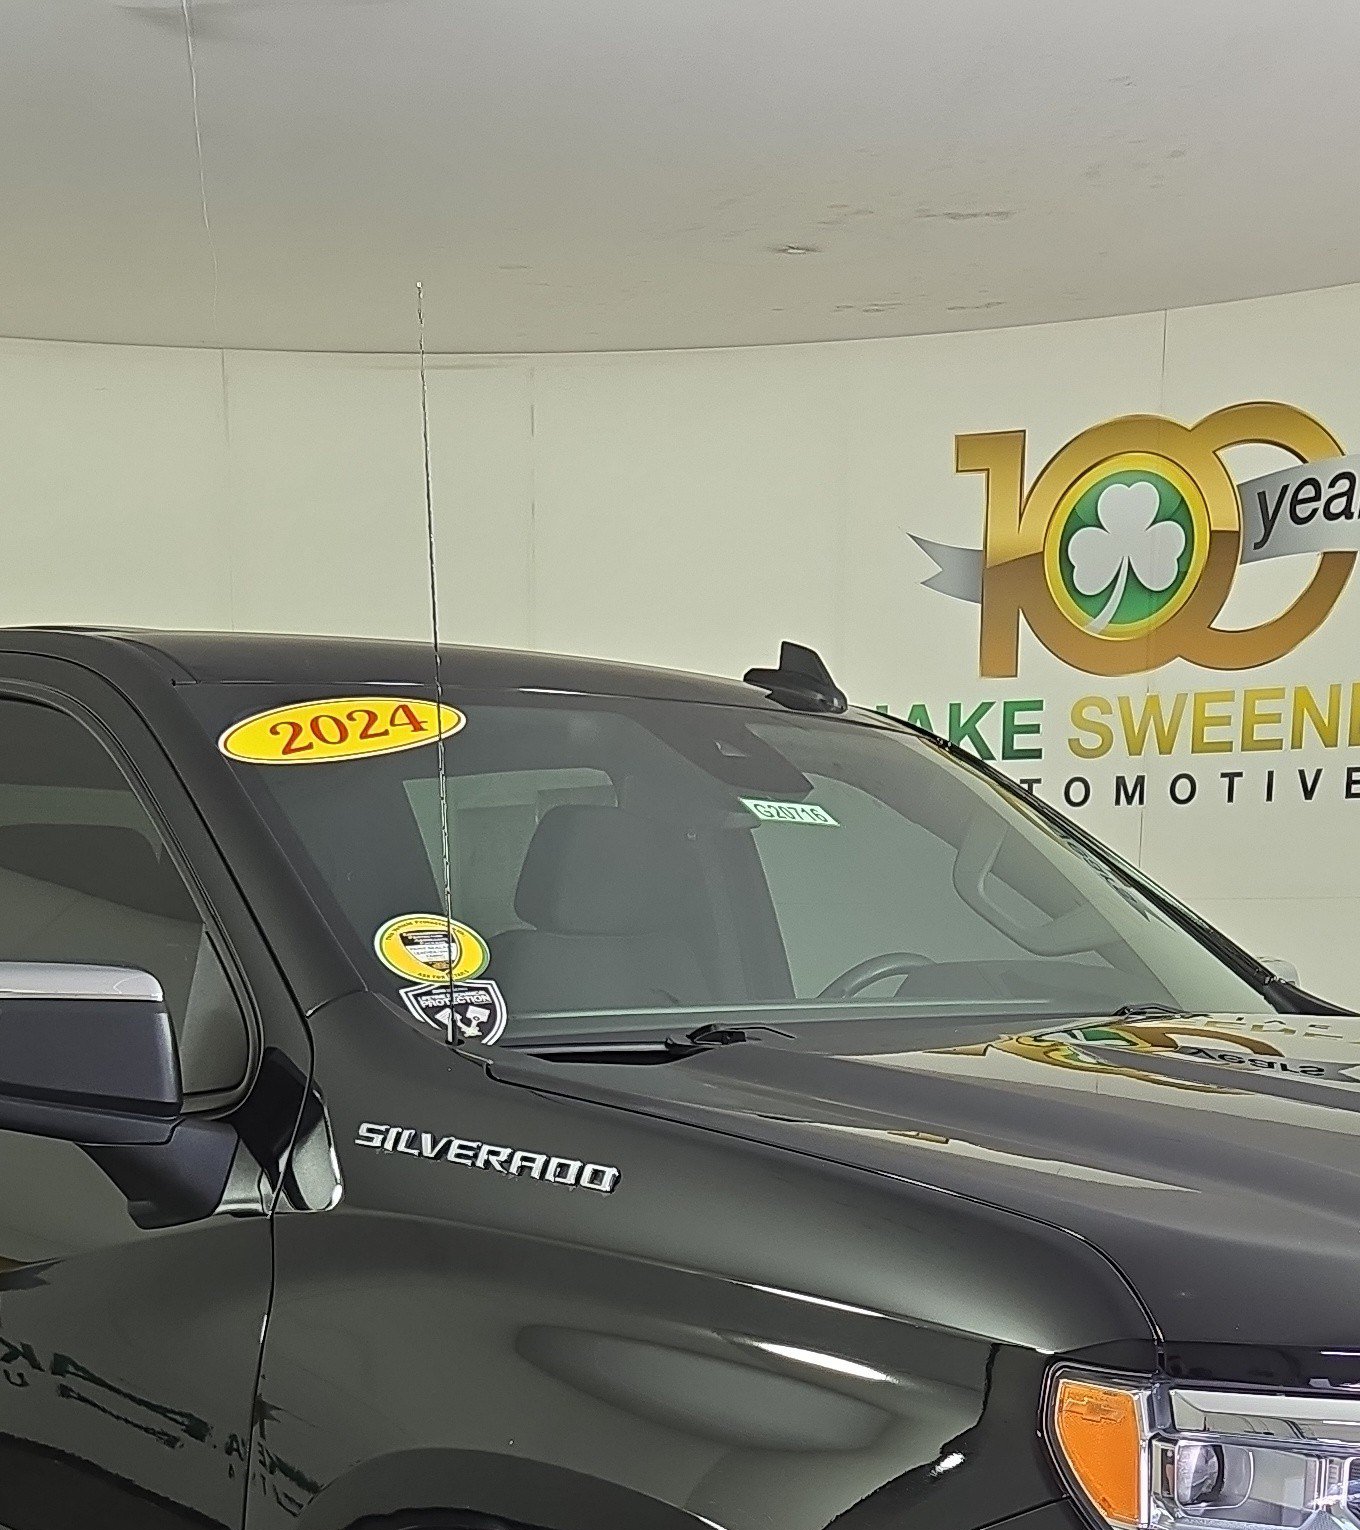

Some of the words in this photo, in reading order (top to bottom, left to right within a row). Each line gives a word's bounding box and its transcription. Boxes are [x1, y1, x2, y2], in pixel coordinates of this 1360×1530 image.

[954, 400, 1358, 679] 100
[270, 704, 429, 756] 2024
[753, 803, 829, 823] G20716
[354, 1122, 621, 1195] SILVERADO
